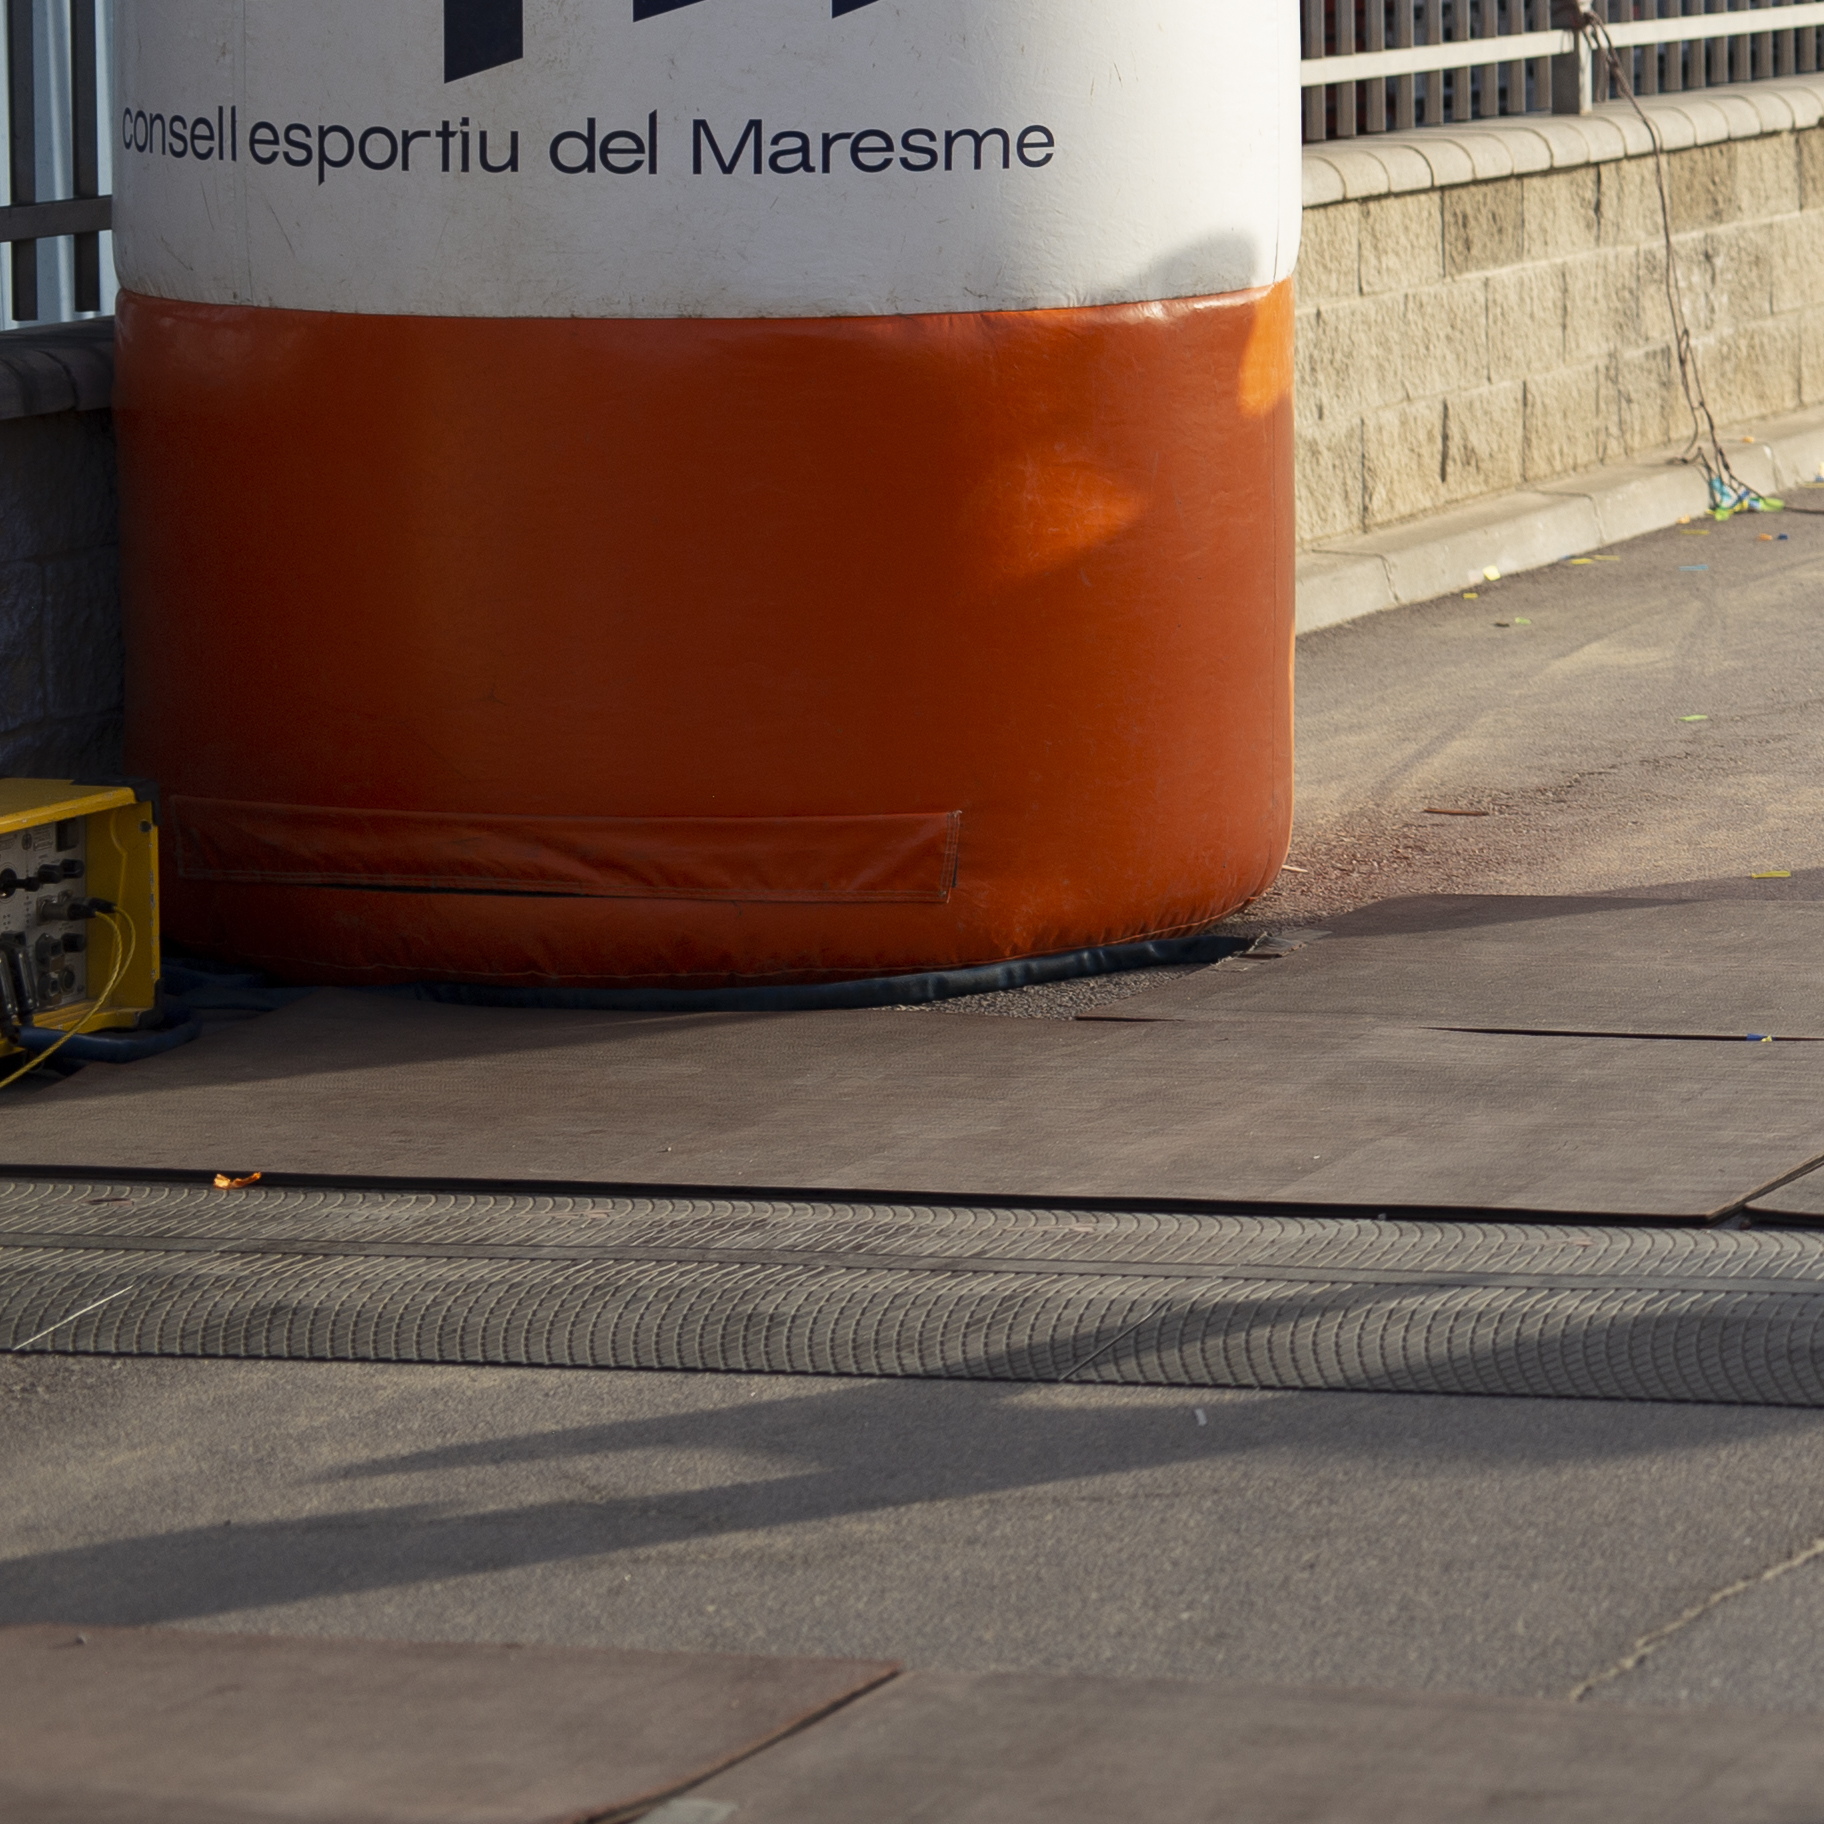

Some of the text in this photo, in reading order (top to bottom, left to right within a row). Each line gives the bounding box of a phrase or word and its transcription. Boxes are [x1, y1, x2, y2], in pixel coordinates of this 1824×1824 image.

[122, 105, 1055, 186] consell esportiu del Maresme
